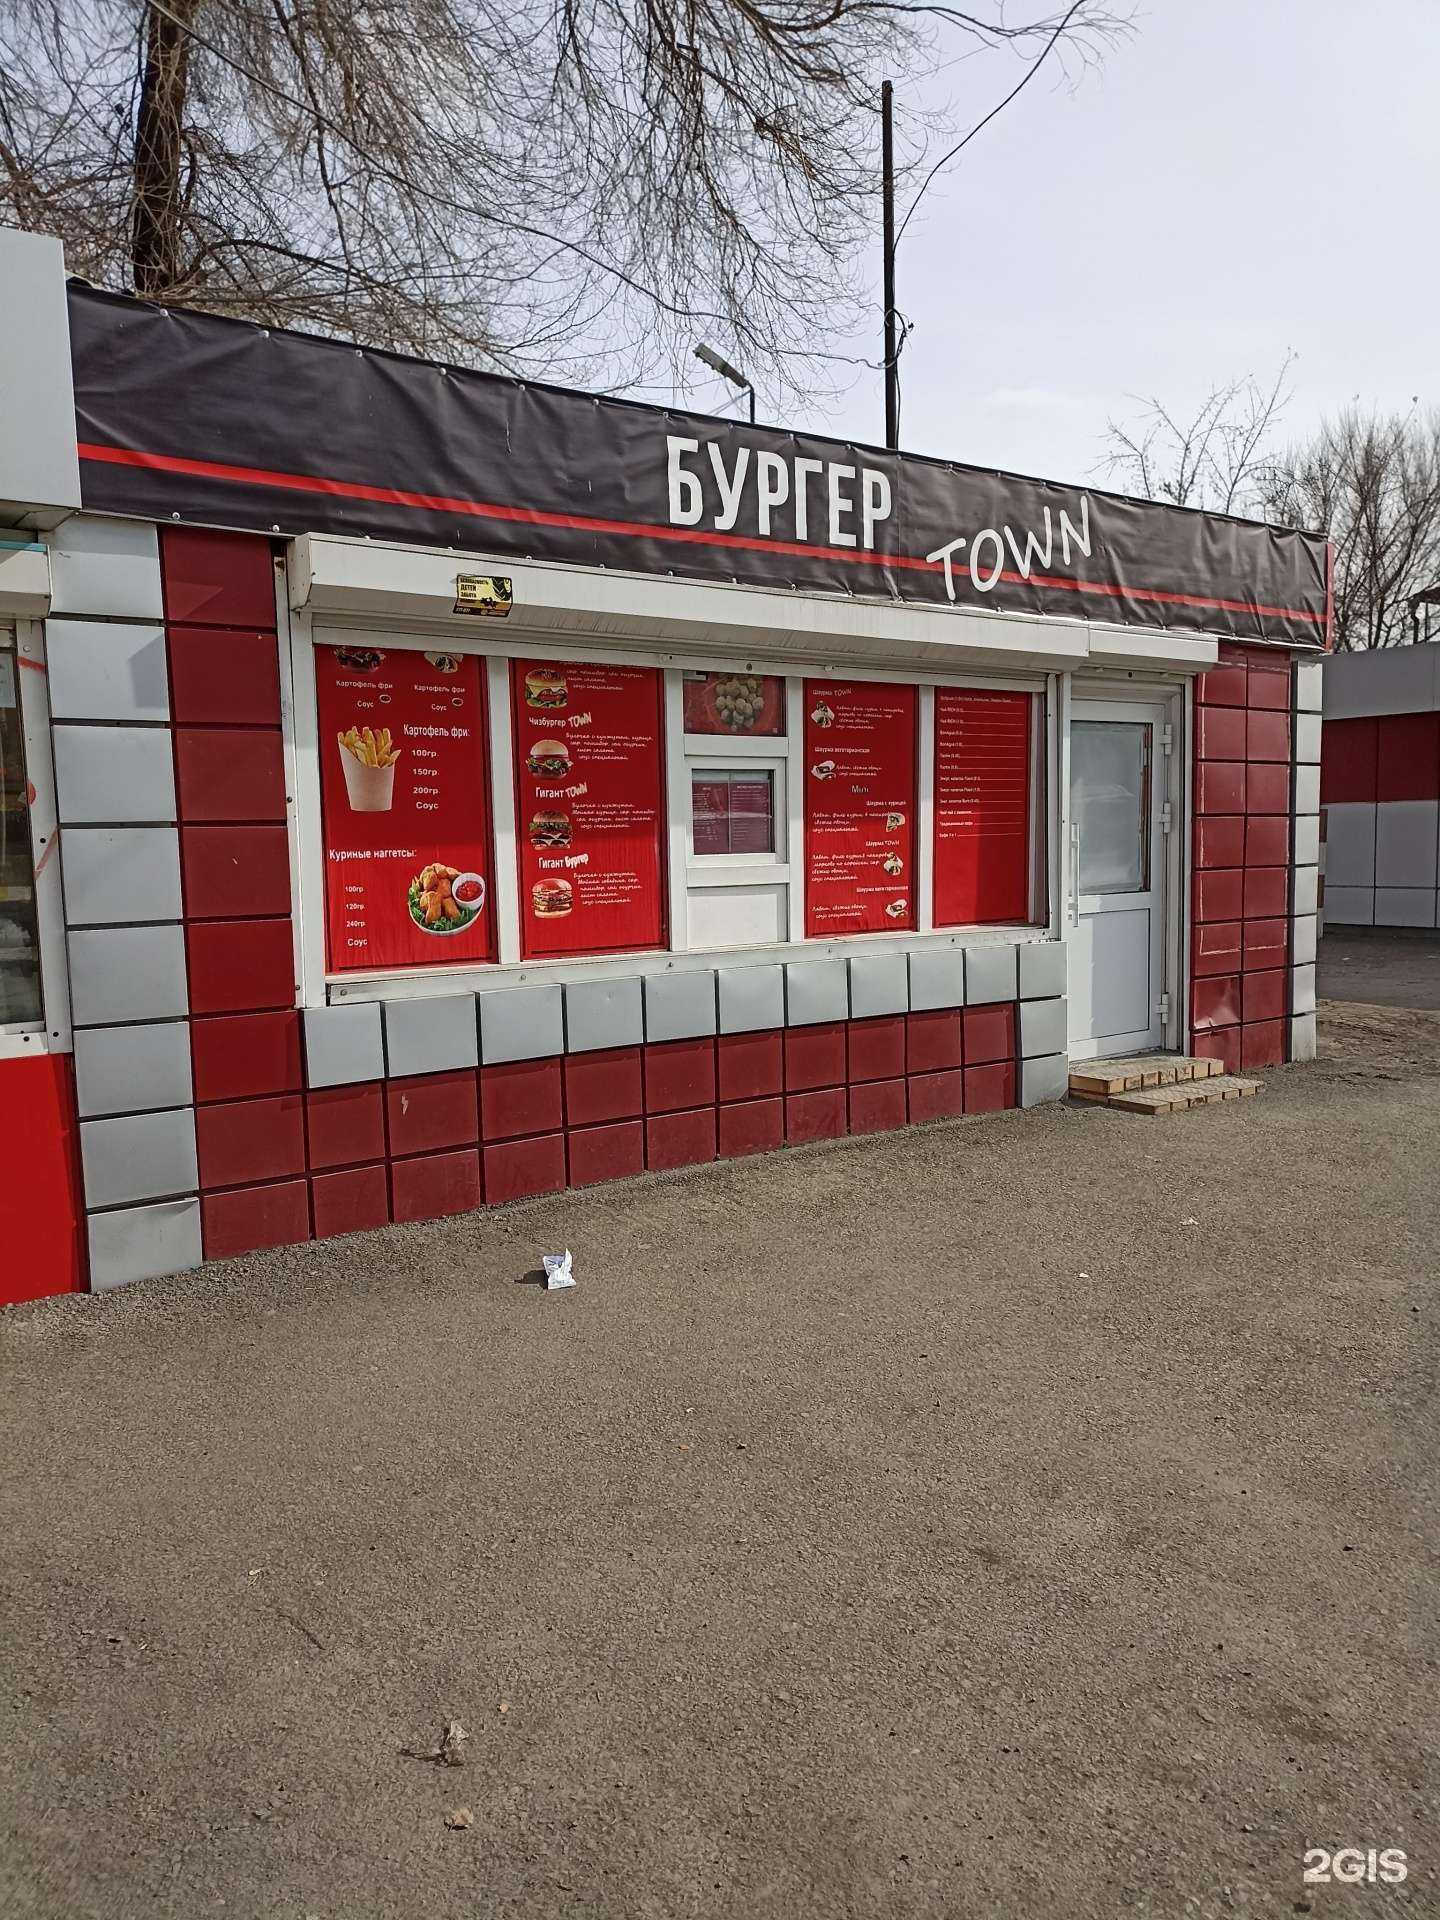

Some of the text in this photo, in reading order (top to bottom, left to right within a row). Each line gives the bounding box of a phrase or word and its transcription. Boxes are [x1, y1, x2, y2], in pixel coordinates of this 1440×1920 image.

[666, 435, 892, 549] БУРГЕР
[926, 495, 1092, 600] TOWN
[336, 680, 393, 690] Картофель фри
[414, 684, 450, 692] Картофель
[357, 700, 374, 708] Соус
[431, 703, 447, 711] Соус
[528, 716, 566, 728] Чизбургер
[404, 724, 470, 738] Картофель фри:
[412, 750, 439, 758] 100гр.
[413, 768, 440, 776] 150гр.
[536, 786, 564, 798] Гигант
[416, 801, 438, 810] Соус
[329, 849, 417, 862] Куриные наггетсы:
[538, 857, 564, 868] Гигант
[347, 938, 368, 947] Соус
